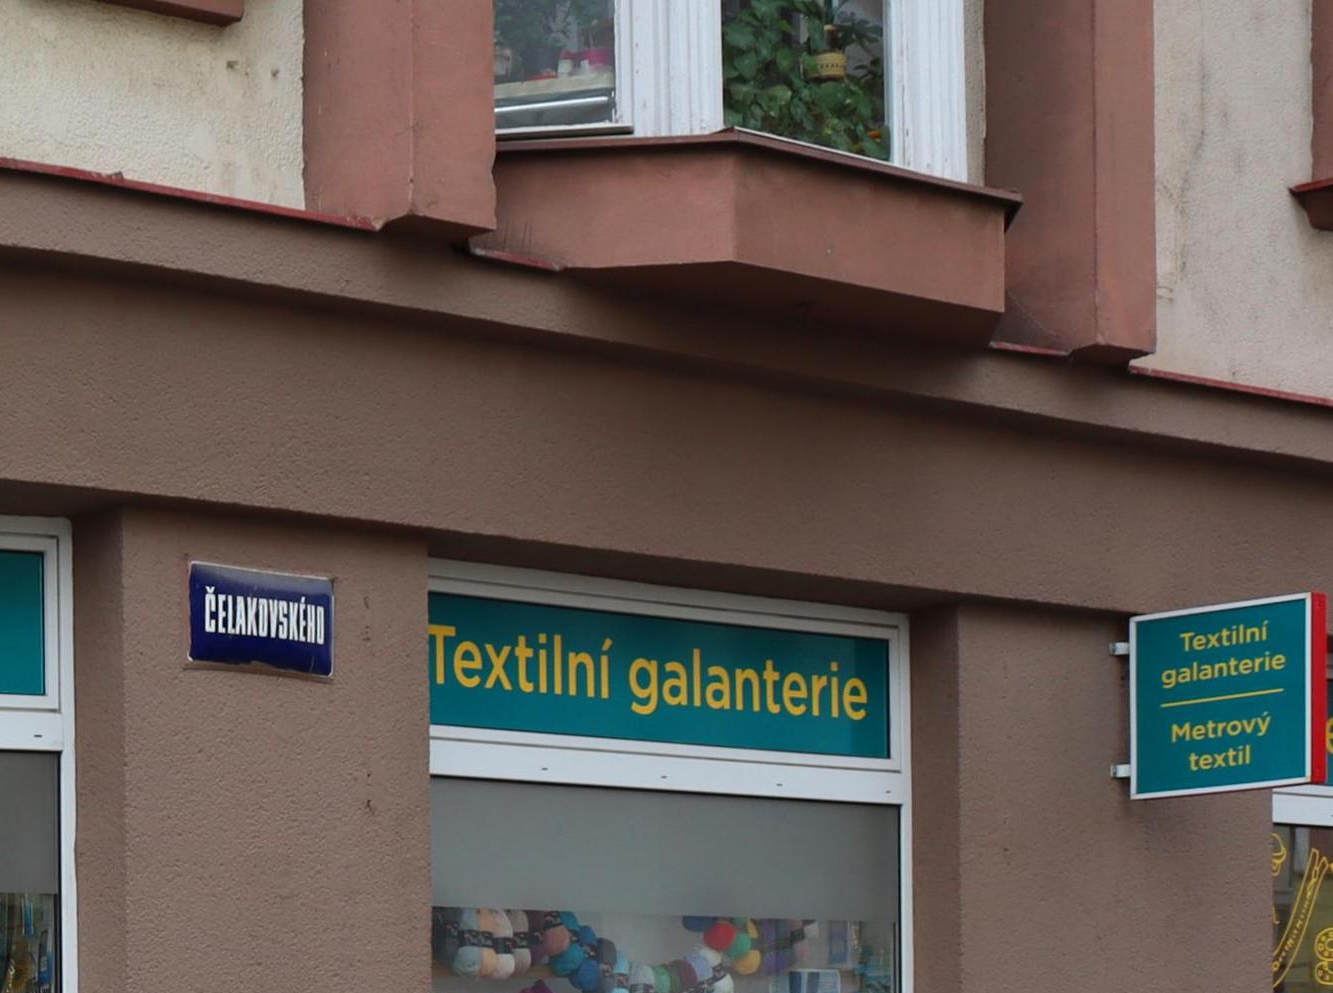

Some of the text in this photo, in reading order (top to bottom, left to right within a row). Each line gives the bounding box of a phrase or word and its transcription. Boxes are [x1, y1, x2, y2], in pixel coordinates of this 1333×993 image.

[204, 586, 325, 645] ČELAKOVSKÉHO
[1180, 620, 1269, 652] Textilní
[428, 624, 868, 721] Textilní galanterie
[1161, 651, 1286, 688] galanterie
[1171, 711, 1272, 743] Metrový
[1189, 745, 1251, 771] textil
